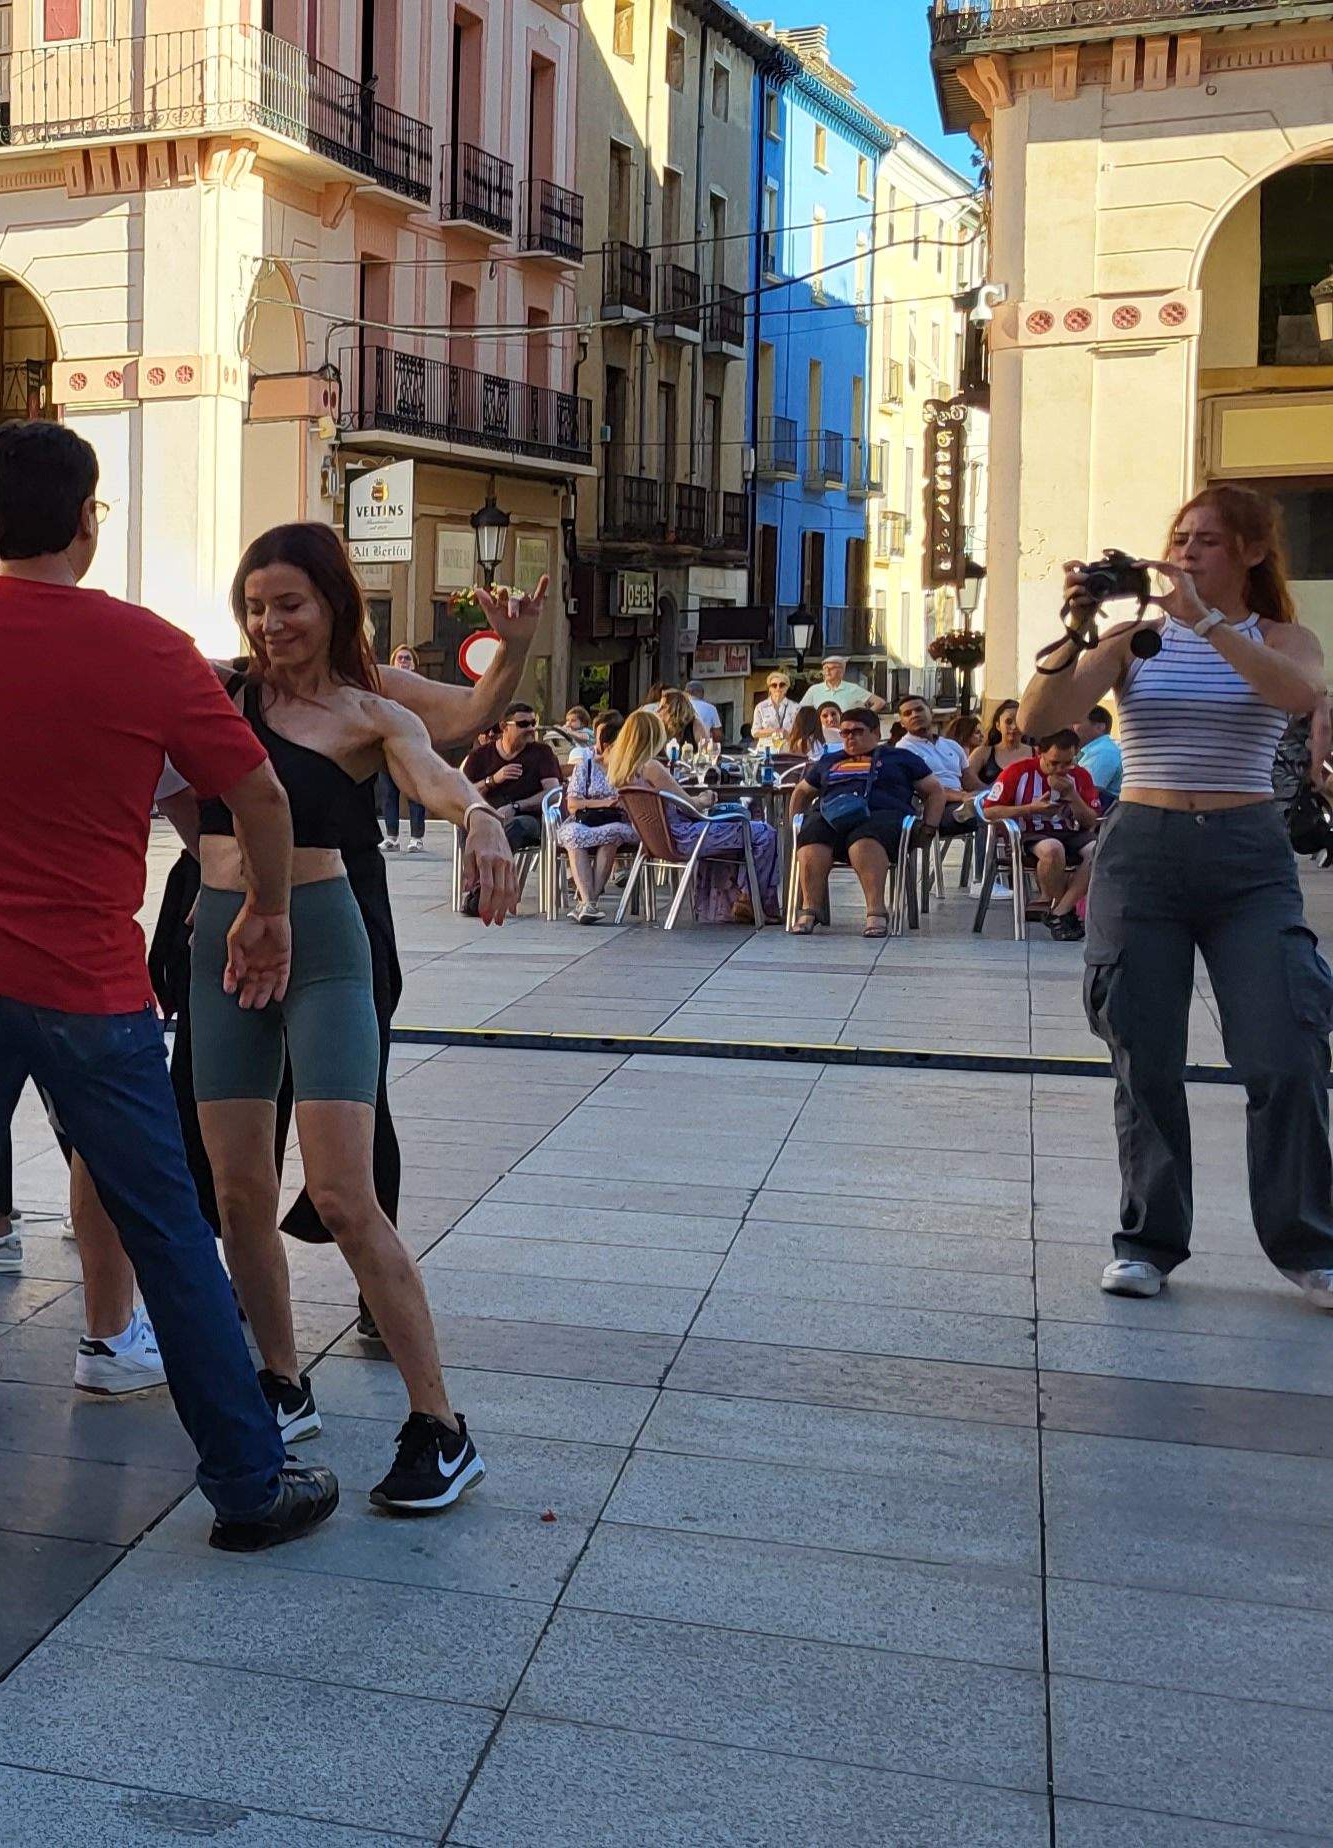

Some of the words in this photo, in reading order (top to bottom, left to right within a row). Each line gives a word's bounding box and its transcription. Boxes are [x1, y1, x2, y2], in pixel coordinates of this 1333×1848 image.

[356, 504, 404, 518] VELTINS
[353, 546, 369, 558] Alt
[373, 545, 407, 558] Berlin
